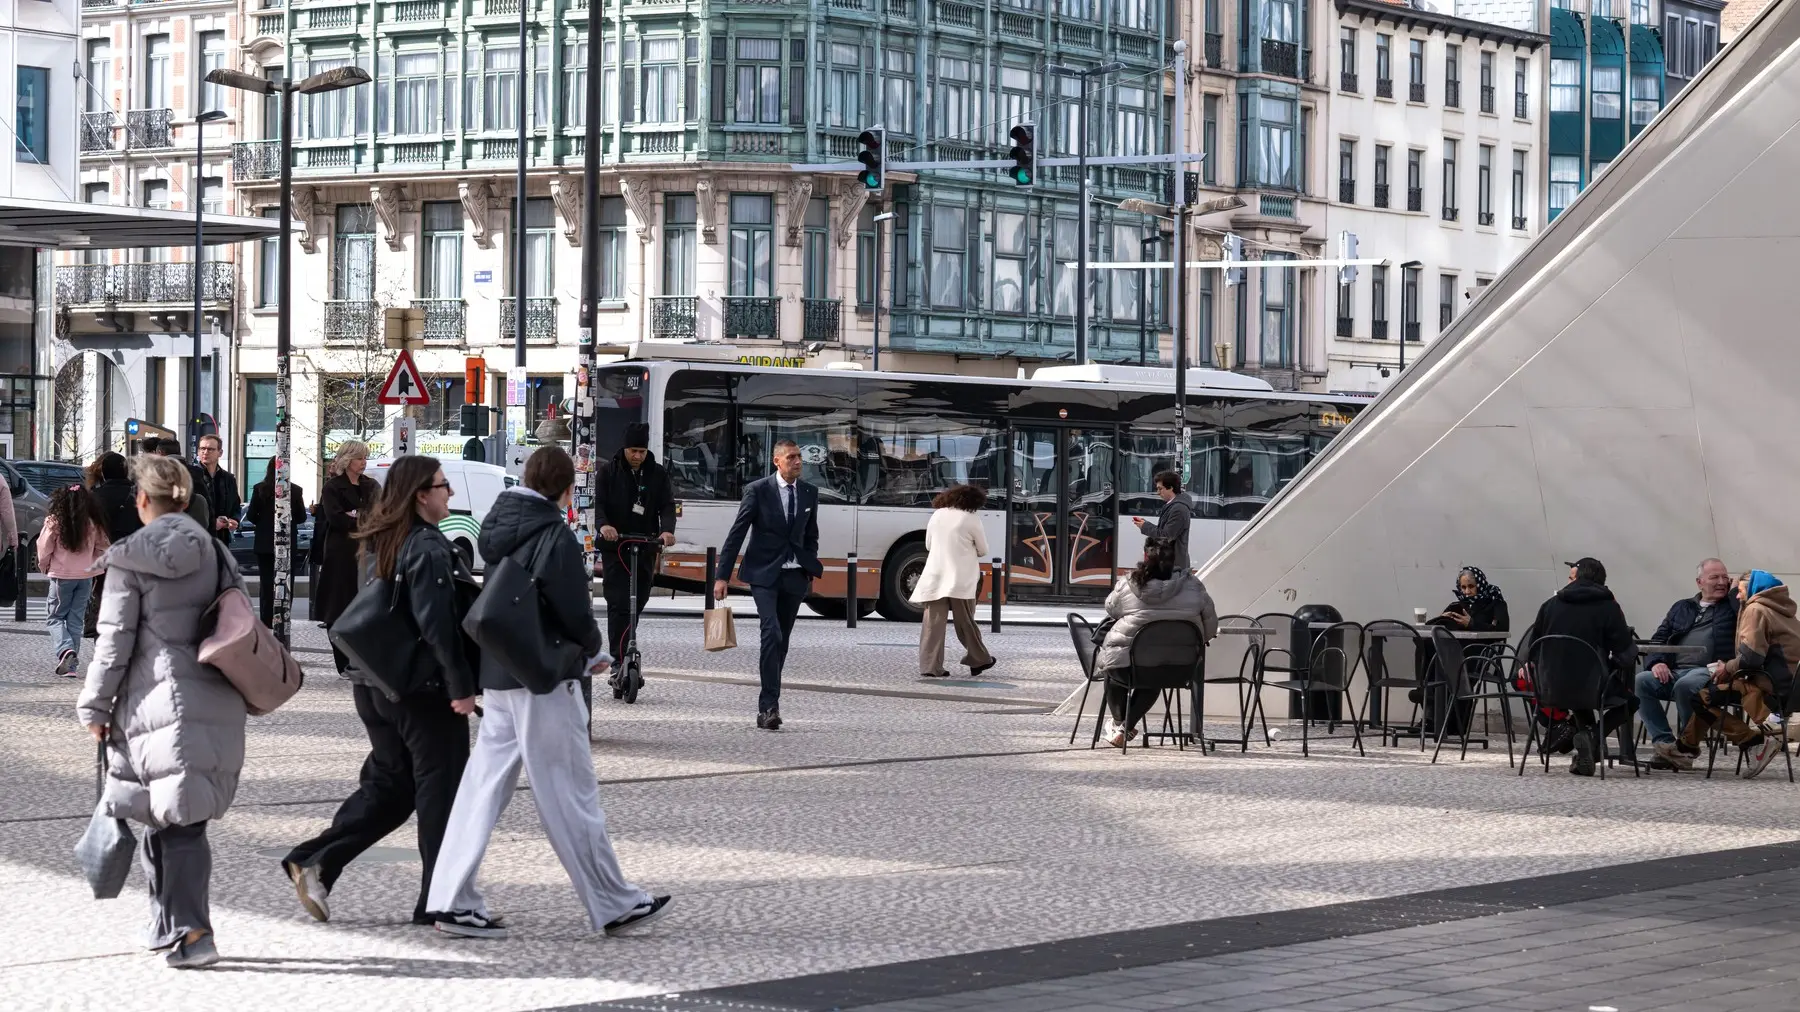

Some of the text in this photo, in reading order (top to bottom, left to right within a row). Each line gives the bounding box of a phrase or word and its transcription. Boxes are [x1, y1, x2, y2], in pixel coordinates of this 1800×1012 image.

[736, 356, 805, 368] AURANT
[627, 376, 639, 387] 9611
[1322, 412, 1336, 426] 61
